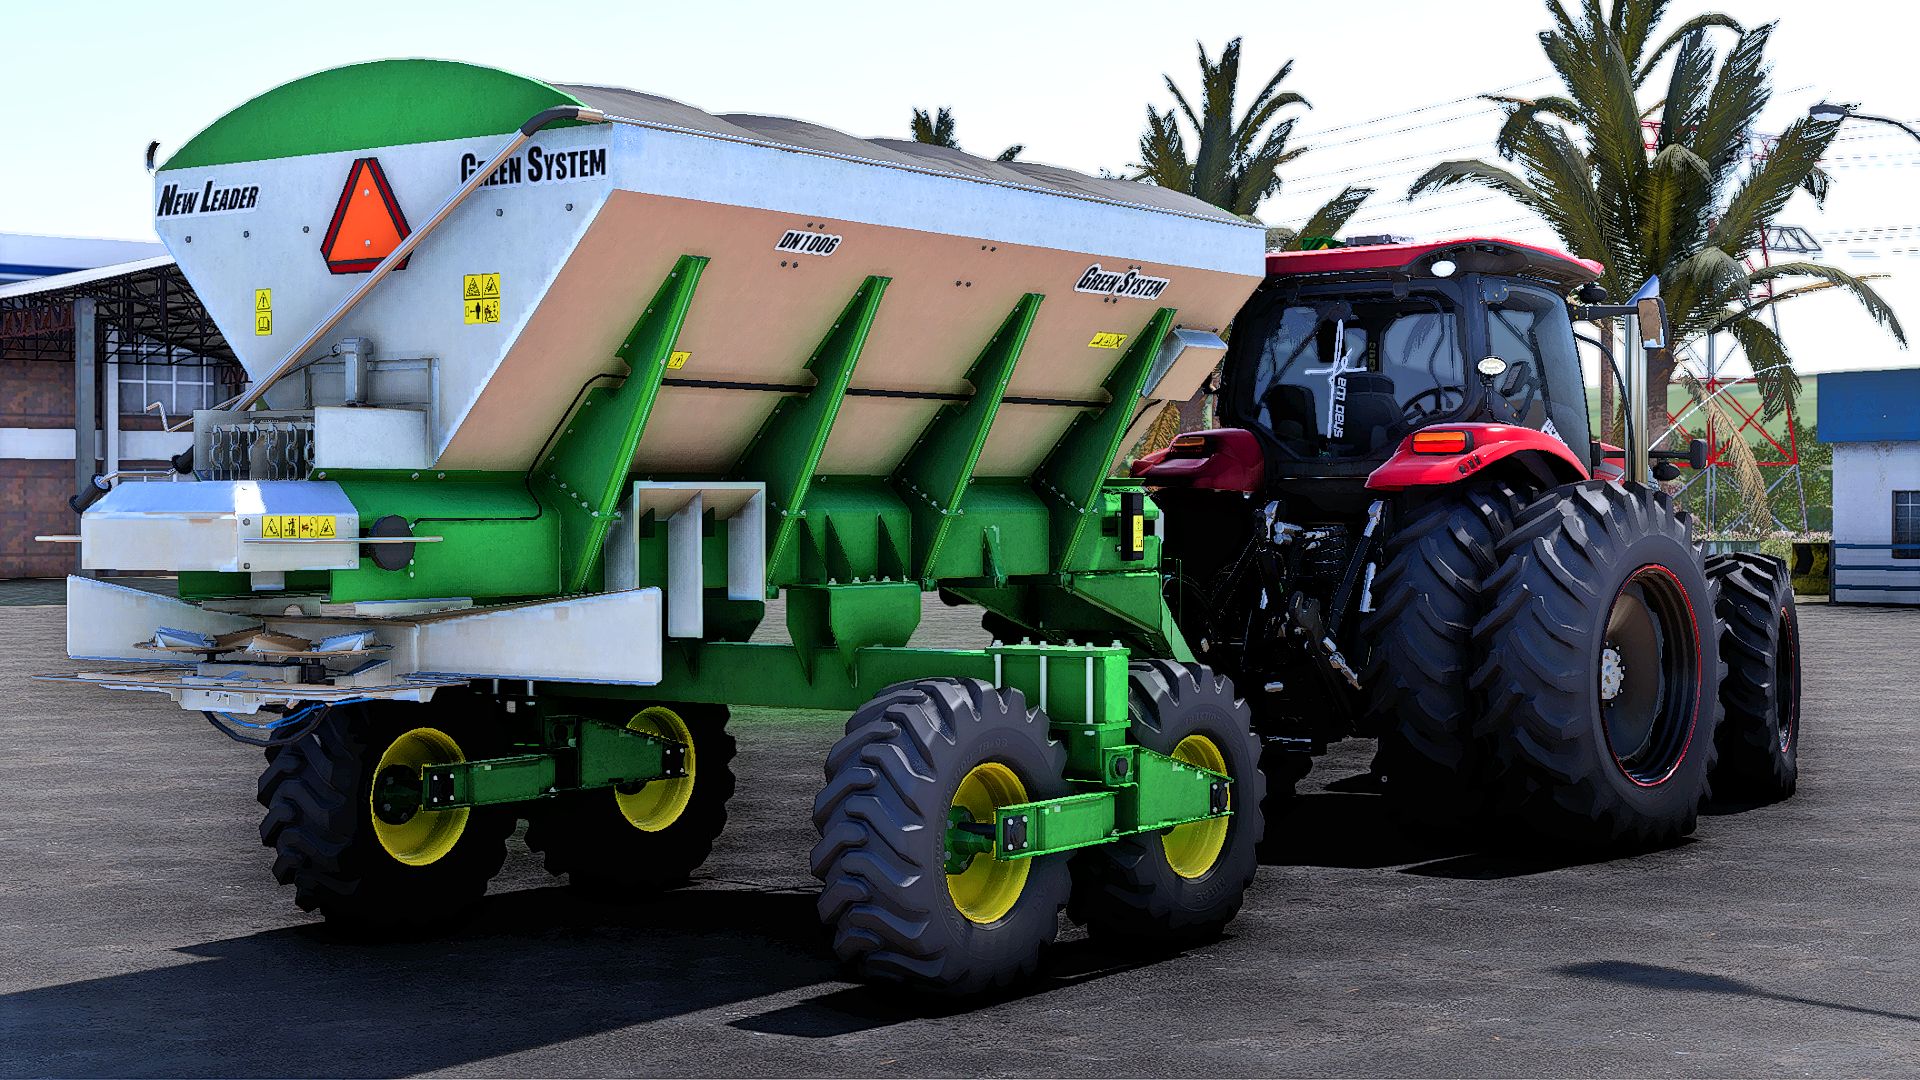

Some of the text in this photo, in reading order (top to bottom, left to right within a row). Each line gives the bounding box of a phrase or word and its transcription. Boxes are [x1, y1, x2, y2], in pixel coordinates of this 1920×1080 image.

[527, 146, 606, 182] SYSTEM
[157, 180, 259, 217] NEW LEADER
[778, 232, 840, 254] DN1006
[1077, 266, 1168, 298] GREEN SYSTEM
